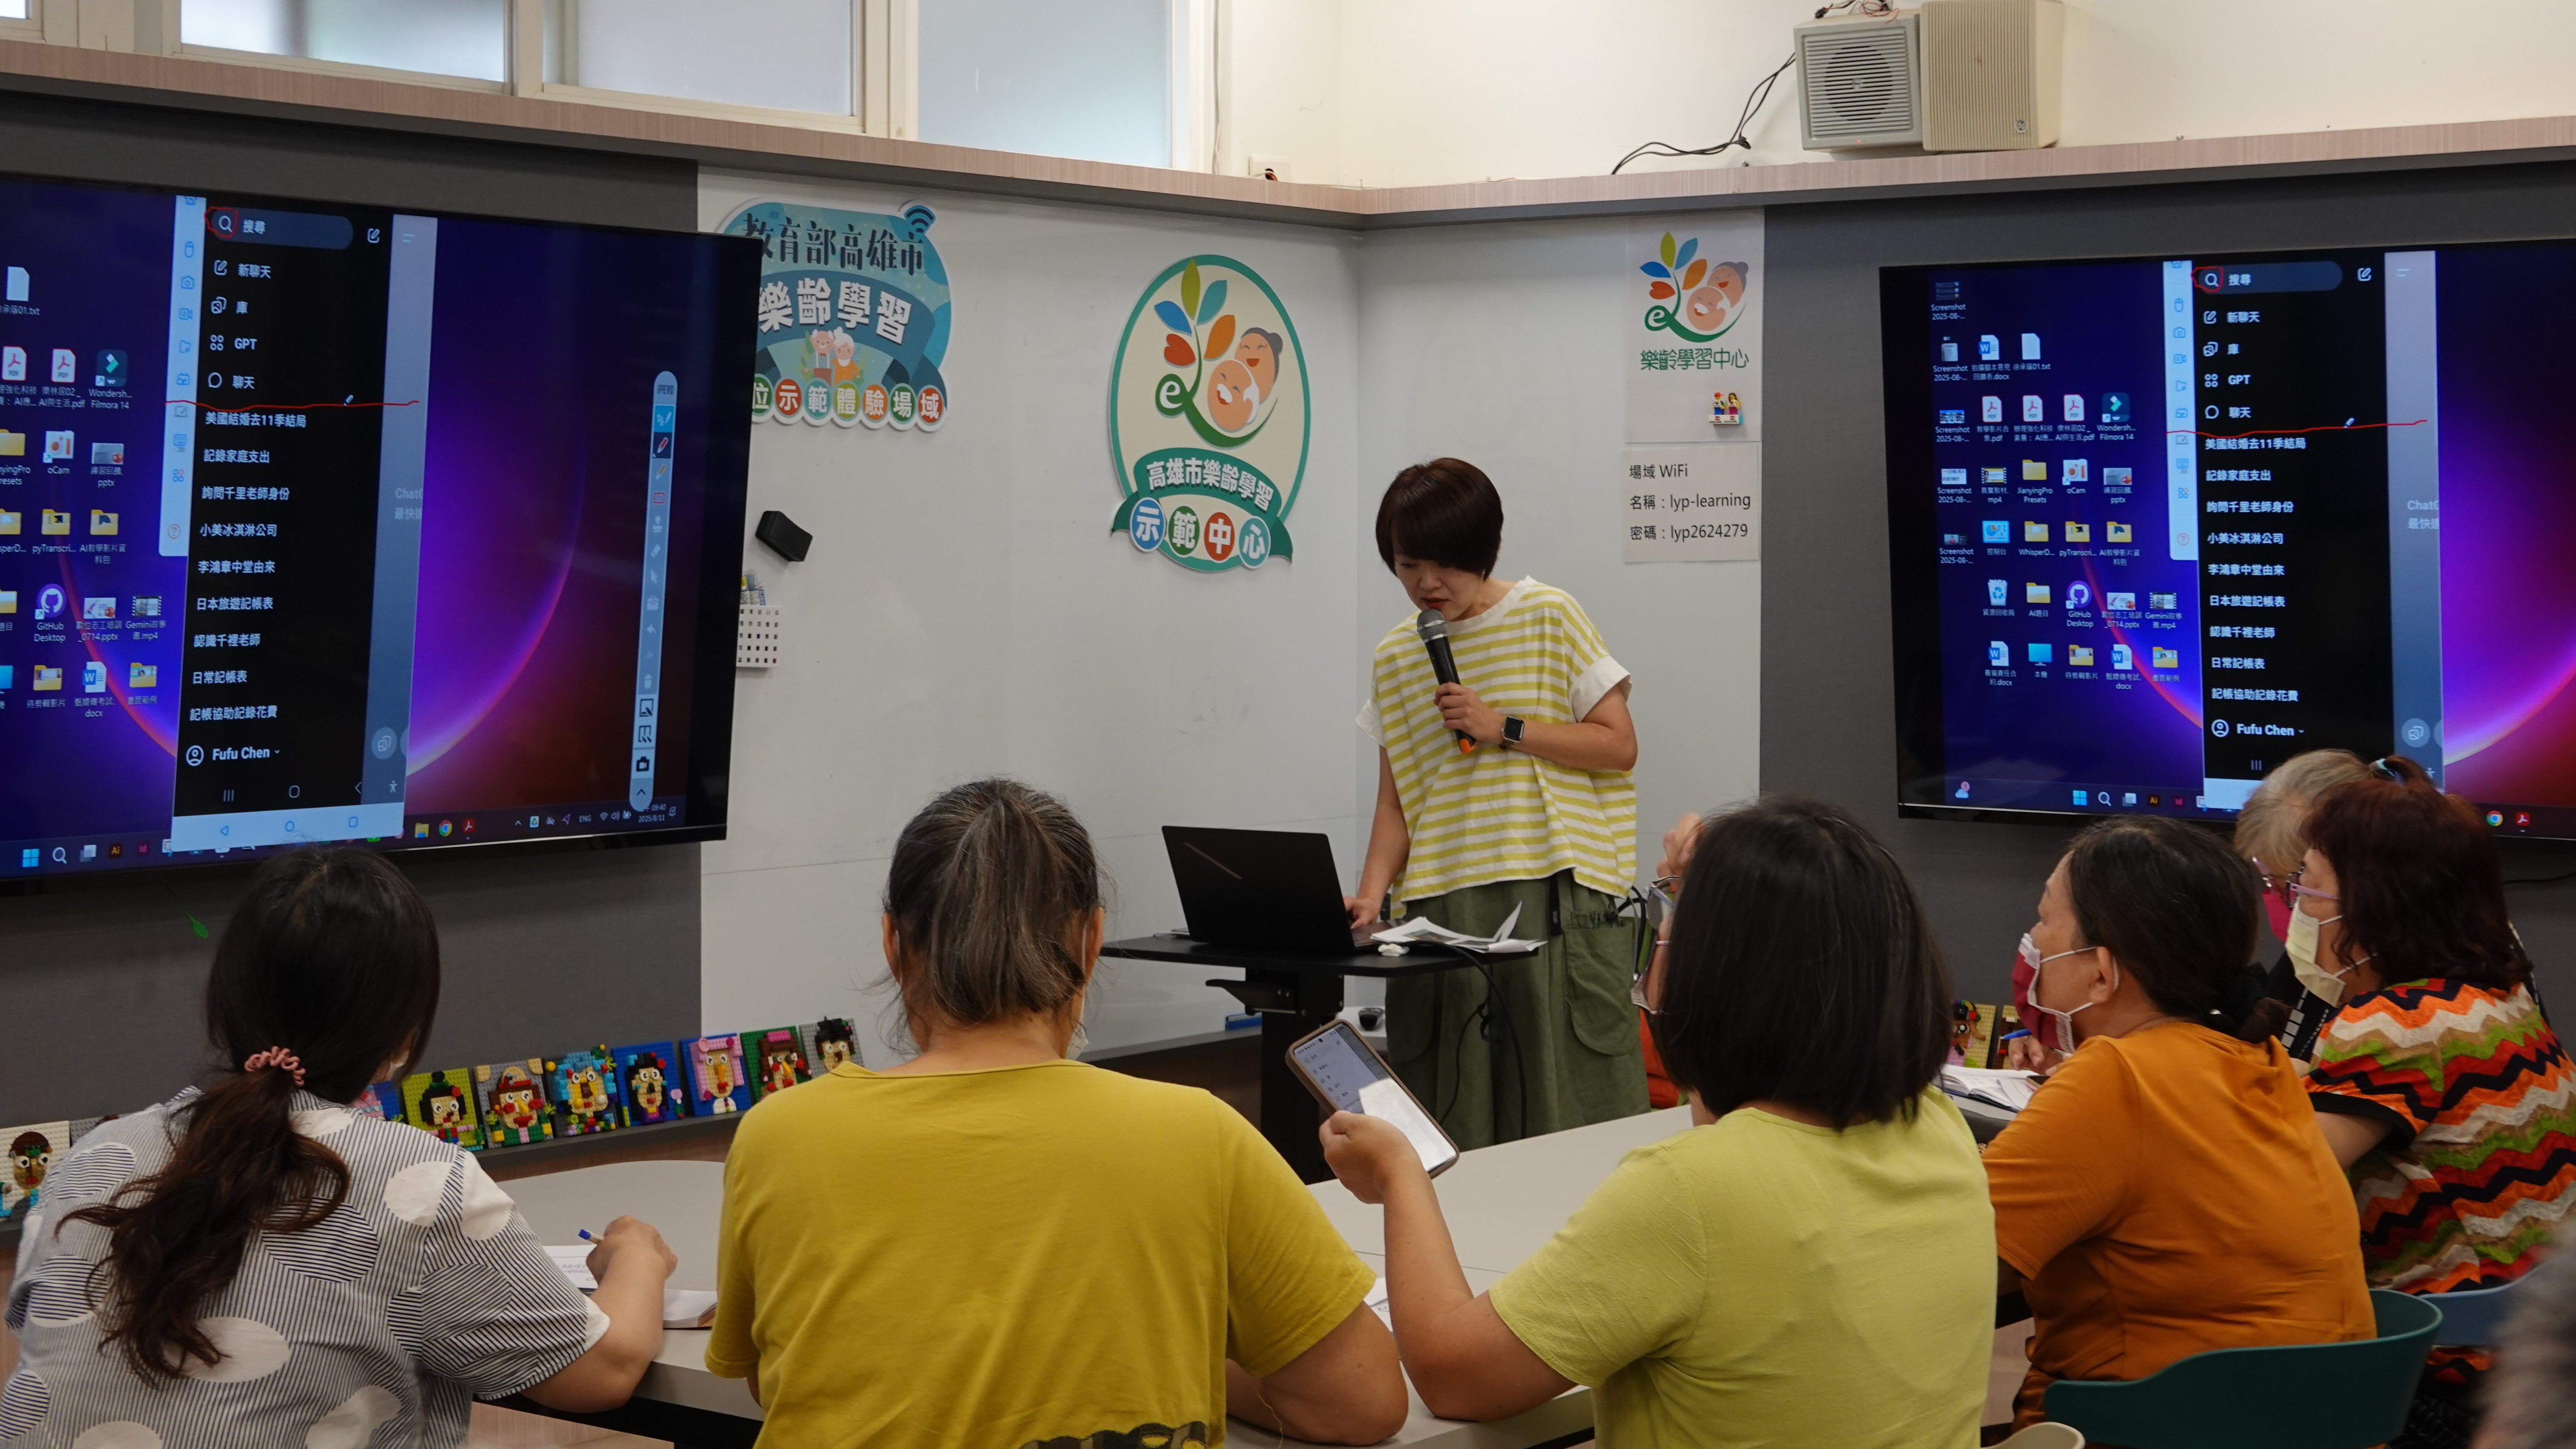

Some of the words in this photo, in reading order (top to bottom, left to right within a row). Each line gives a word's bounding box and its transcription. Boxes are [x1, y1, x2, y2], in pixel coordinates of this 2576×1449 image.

[243, 219, 266, 235] 搜尋
[744, 212, 923, 276] 教育部高雄市
[238, 263, 272, 279] 新聊天
[2229, 274, 2252, 286] 搜尋
[236, 301, 248, 315] 庫
[758, 277, 912, 345] 樂齡學習
[2227, 311, 2260, 324] 新聊天
[234, 338, 258, 350] GPT
[2228, 343, 2239, 355] 庫
[1641, 348, 1749, 371] 樂齡學習中心
[233, 375, 255, 389] 聊天
[2228, 375, 2251, 385] GPT
[91, 400, 118, 409] Filmora
[121, 401, 129, 409] 14
[753, 382, 942, 420] 位示範體驗場域
[205, 411, 306, 428] 美國結婚去11季結局
[2229, 406, 2251, 419] 聊天
[2205, 437, 2306, 450] 美國結婚去11季結局
[203, 449, 270, 464] 記錄家庭支出
[47, 466, 70, 475] oCam
[1629, 464, 1655, 479] 場域
[1659, 463, 1688, 478] WiFi
[2206, 470, 2271, 481] 記錄家庭支出
[1147, 456, 1275, 512] 高雄市樂齡學習
[201, 486, 290, 501] 詢問千里老師身份
[2206, 501, 2294, 513] 詢問千里老師身份
[200, 523, 277, 537] 小美冰淇淋公司
[1135, 506, 1265, 559] 示範中心
[2207, 533, 2284, 544] 小美冰淇淋公司
[198, 560, 275, 574] 李鴻章中堂由來
[2208, 564, 2285, 576] 李鴻章中堂由來
[197, 597, 274, 611] 日本旅遊記帳表
[2210, 595, 2286, 607] 日本旅遊記帳表
[37, 622, 64, 630] GitHub
[2067, 620, 2093, 628] Desktop
[34, 634, 66, 643] Desktop
[2212, 657, 2265, 670] 日常記帳表
[193, 670, 248, 685] 日常記帳表
[2212, 688, 2298, 702] 記帳協助記錄花費
[190, 705, 278, 721] 記帳協助記錄花費
[2237, 723, 2262, 735] Fufu
[2265, 724, 2294, 736] Chen
[212, 748, 238, 761] Fufu
[241, 746, 270, 760] Chen
